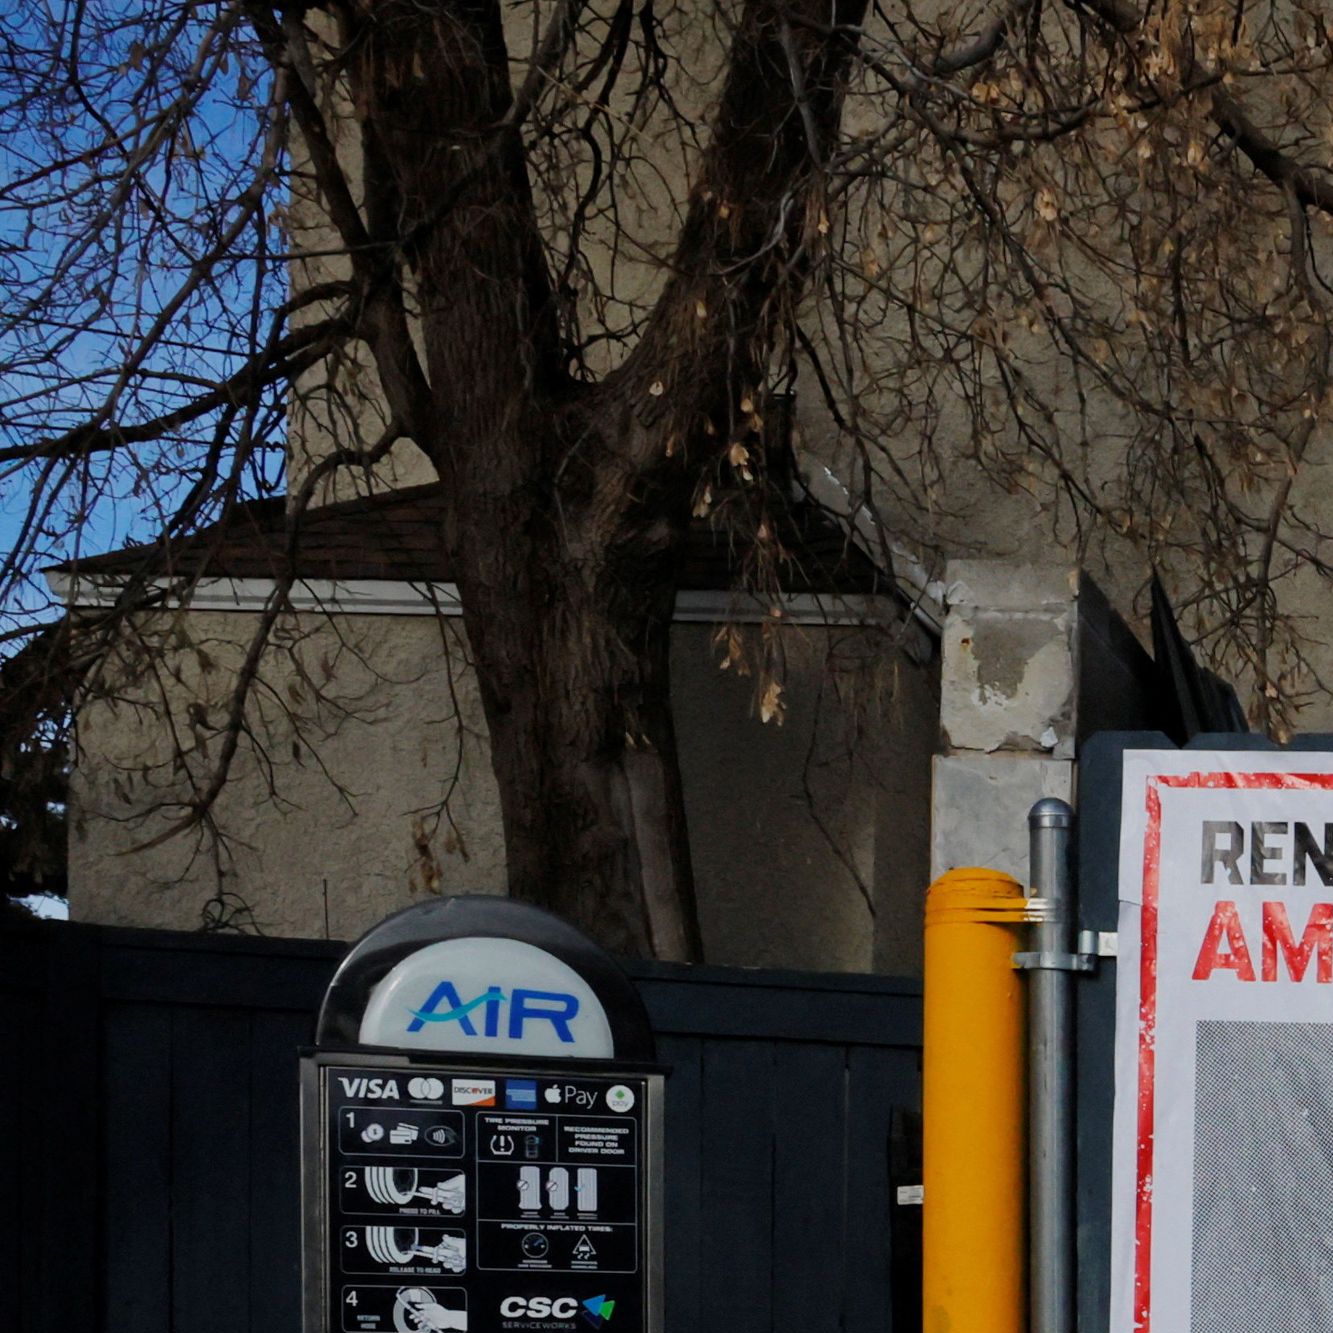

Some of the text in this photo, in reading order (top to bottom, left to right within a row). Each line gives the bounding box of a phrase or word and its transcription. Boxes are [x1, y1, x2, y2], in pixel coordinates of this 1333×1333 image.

[406, 981, 580, 1043] AIR
[338, 1077, 400, 1100] VISA
[453, 1086, 493, 1095] DISCOVER
[565, 1085, 598, 1109] Pay
[346, 1111, 355, 1128] 1
[344, 1171, 357, 1188] 2
[345, 1231, 358, 1248] 3
[345, 1290, 358, 1307] 4
[500, 1296, 578, 1319] CSC
[502, 1322, 577, 1330] SERVICEWORKS
